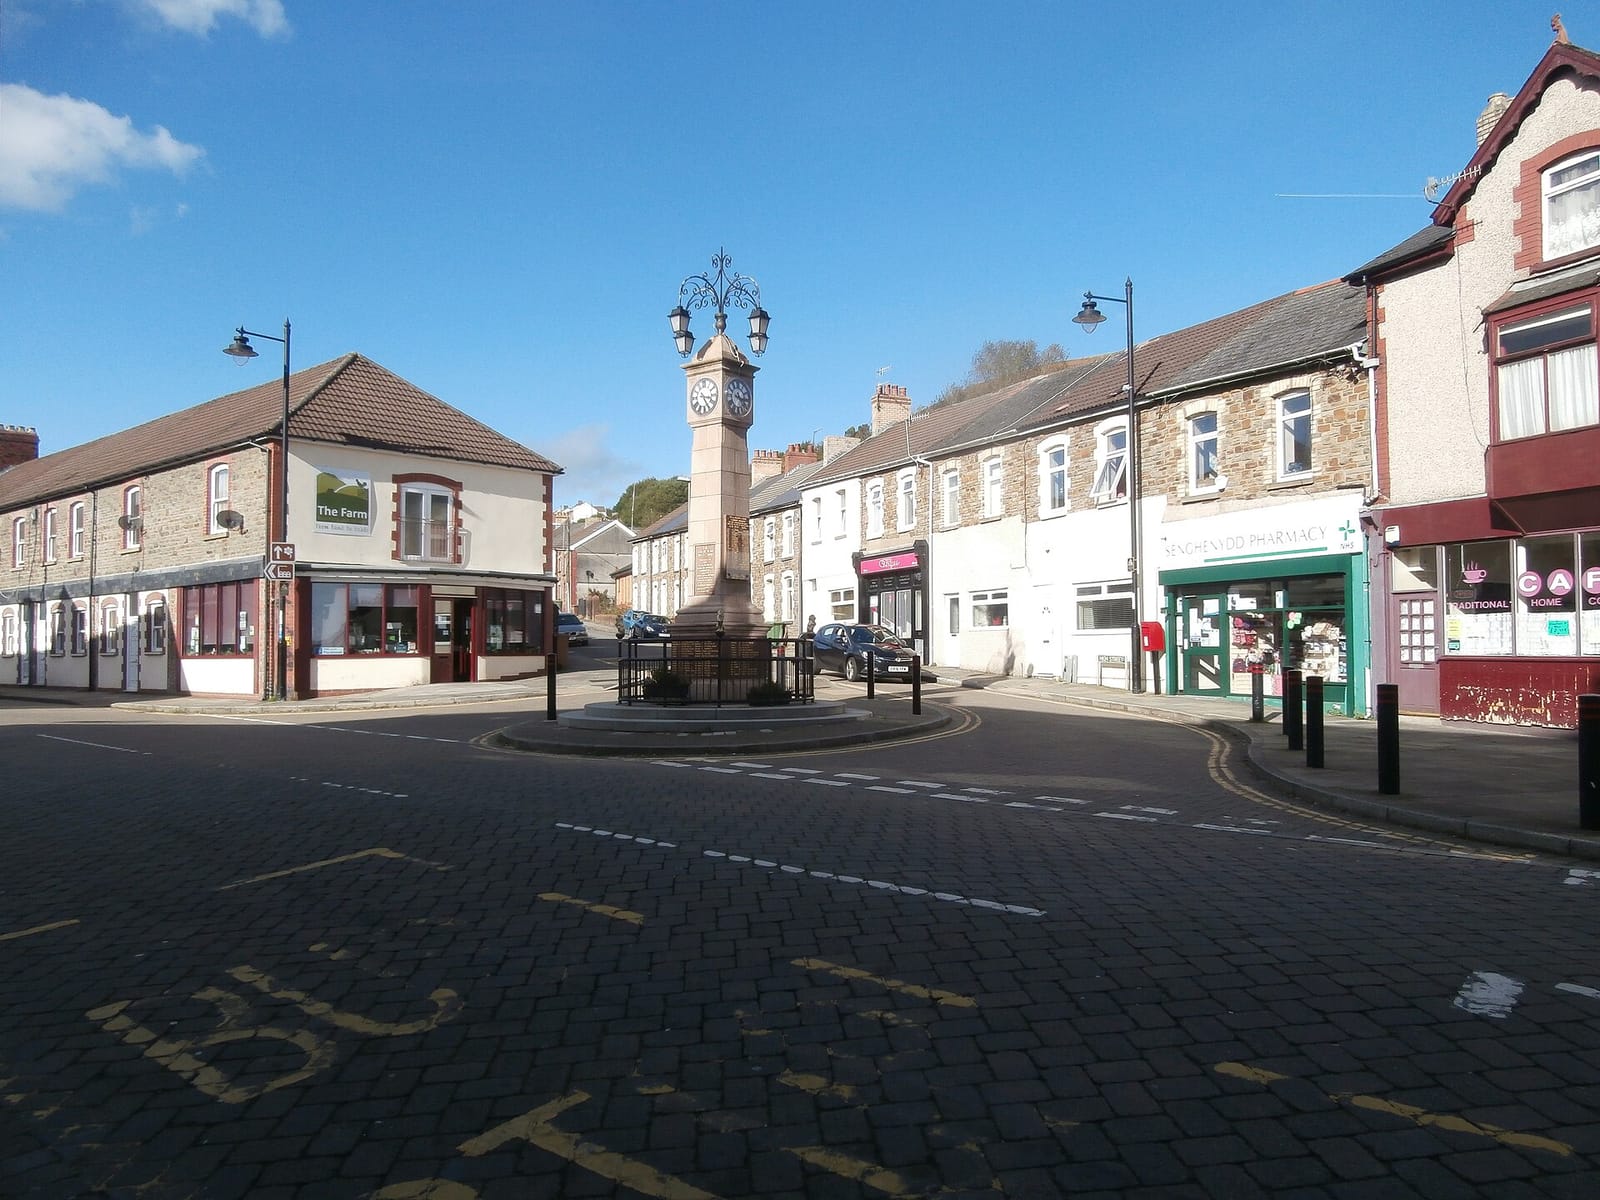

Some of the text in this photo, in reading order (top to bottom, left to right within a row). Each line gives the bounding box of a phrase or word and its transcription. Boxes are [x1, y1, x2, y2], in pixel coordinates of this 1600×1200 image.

[317, 505, 368, 519] The Farm
[1249, 526, 1328, 548] PHARMACY
[1530, 597, 1562, 607] HOME
